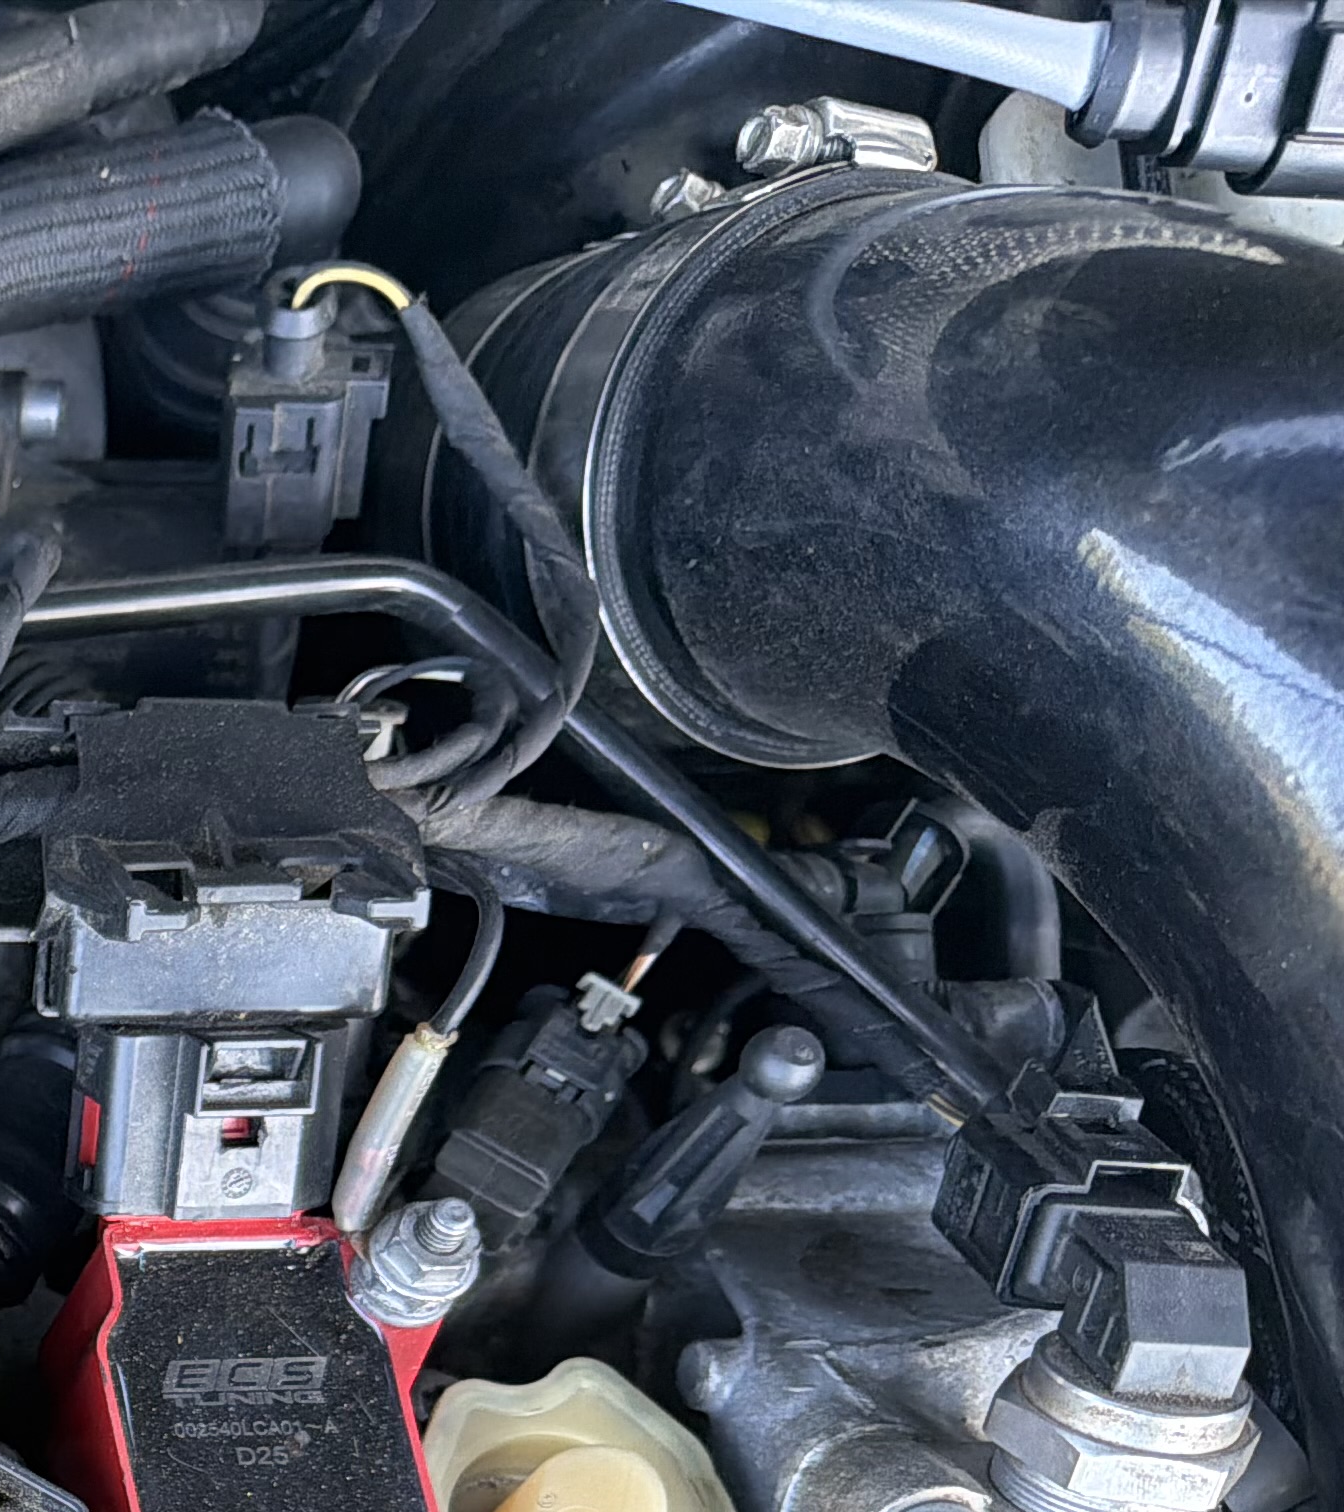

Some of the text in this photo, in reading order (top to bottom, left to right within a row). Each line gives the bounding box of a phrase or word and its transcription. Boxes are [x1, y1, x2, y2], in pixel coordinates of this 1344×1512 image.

[162, 1356, 328, 1394] ECS
[162, 1390, 327, 1407] TUNING
[236, 1447, 289, 1467] D25
